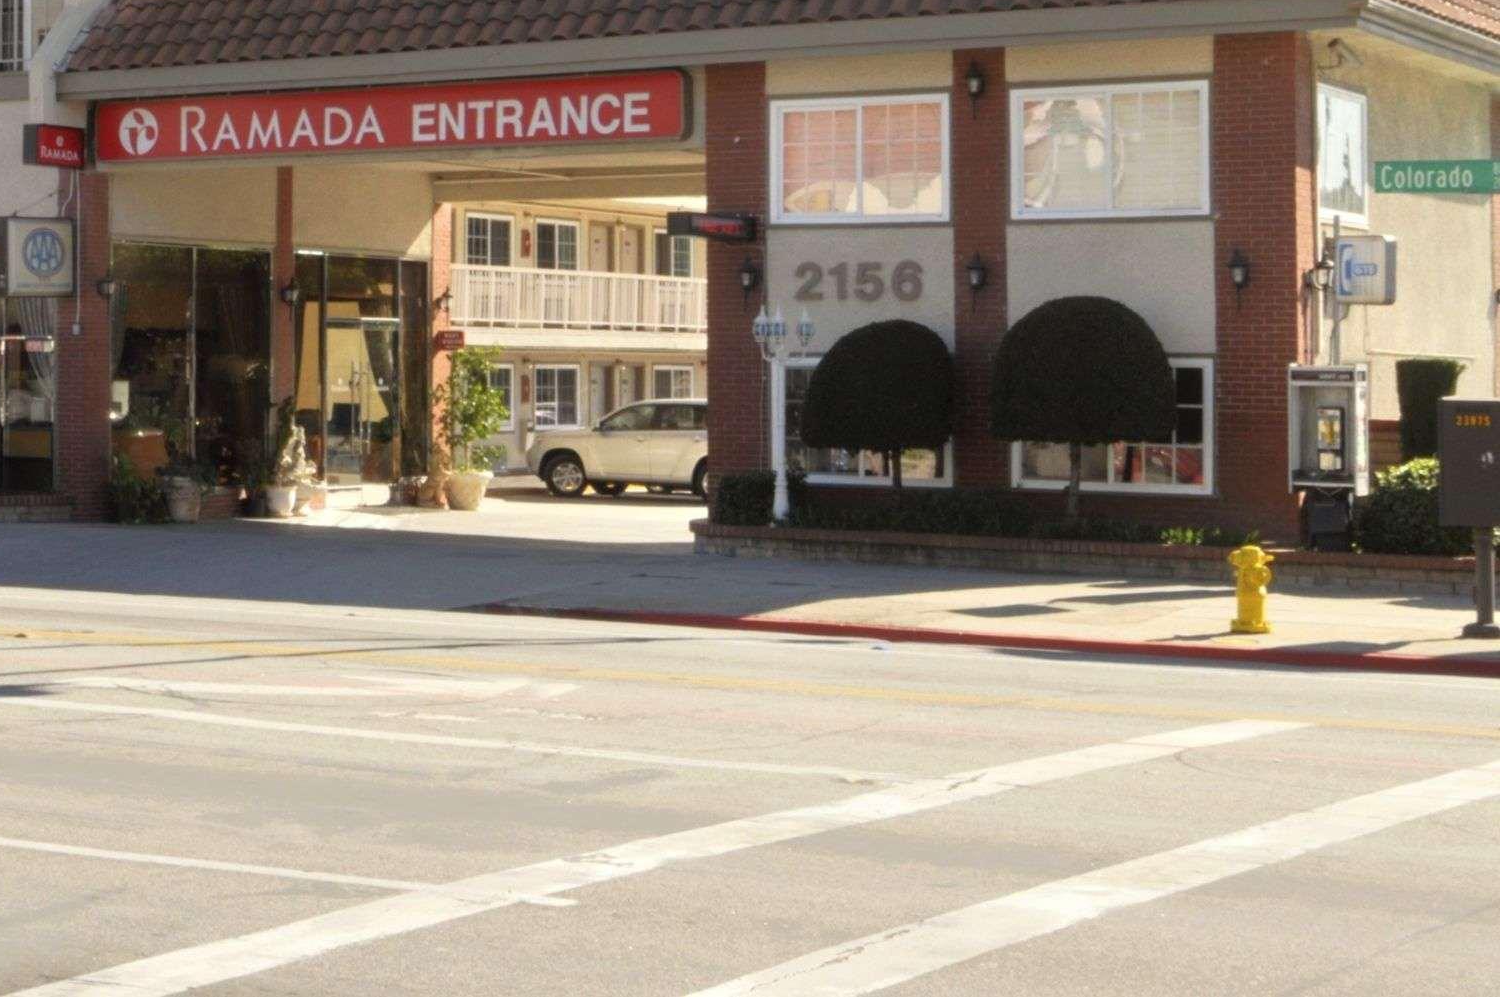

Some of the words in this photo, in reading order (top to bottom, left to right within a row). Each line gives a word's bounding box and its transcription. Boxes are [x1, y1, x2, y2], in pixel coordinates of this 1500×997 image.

[180, 106, 384, 152] RAMADA
[412, 92, 650, 142] ENTRANCE
[40, 145, 79, 160] RAMADA
[1381, 165, 1473, 189] Colorado
[794, 259, 923, 302] 2156
